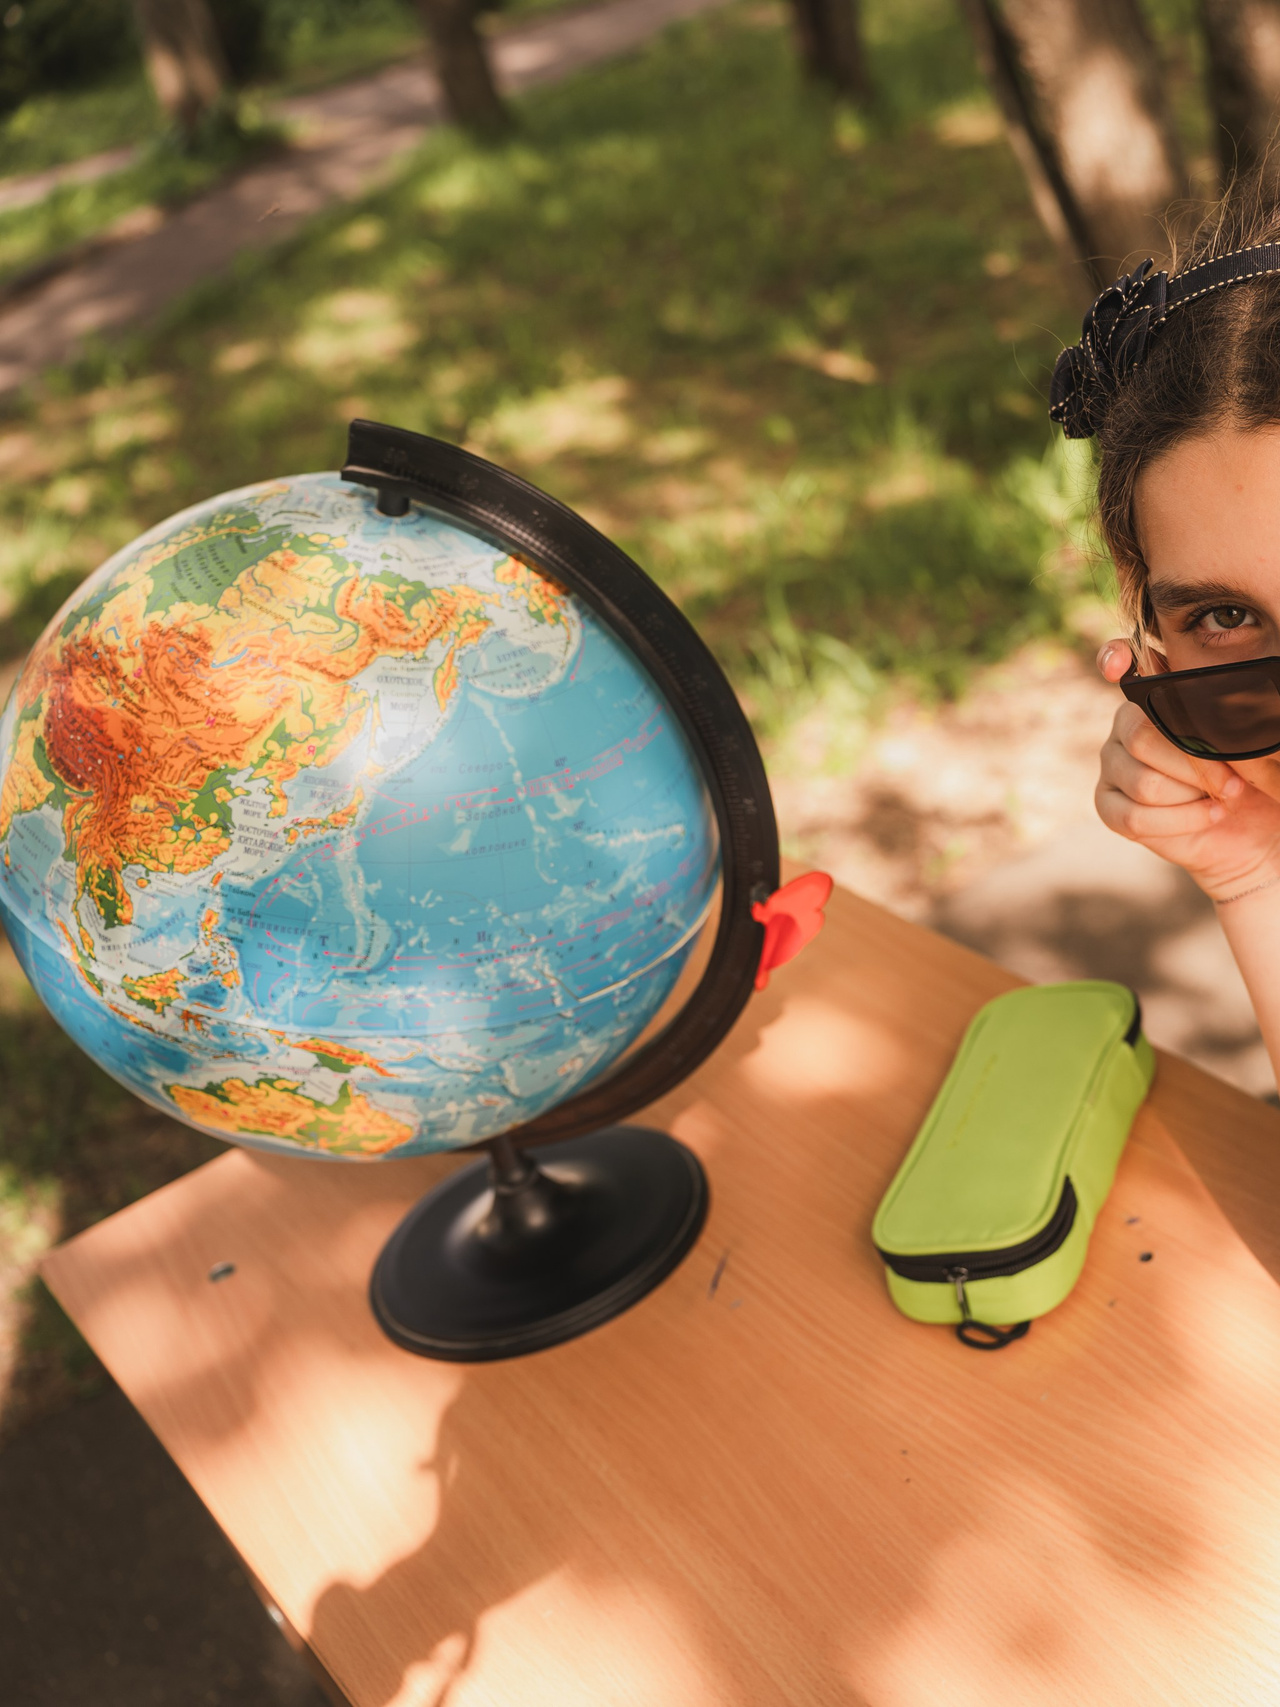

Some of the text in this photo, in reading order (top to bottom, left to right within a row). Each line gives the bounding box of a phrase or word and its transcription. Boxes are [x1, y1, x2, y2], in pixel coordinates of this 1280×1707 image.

[376, 675, 424, 686] ОХОТСКОЕ
[390, 702, 416, 712] МОРЕ
[243, 809, 262, 818] МОРЕ
[243, 847, 265, 857] МОРЕ
